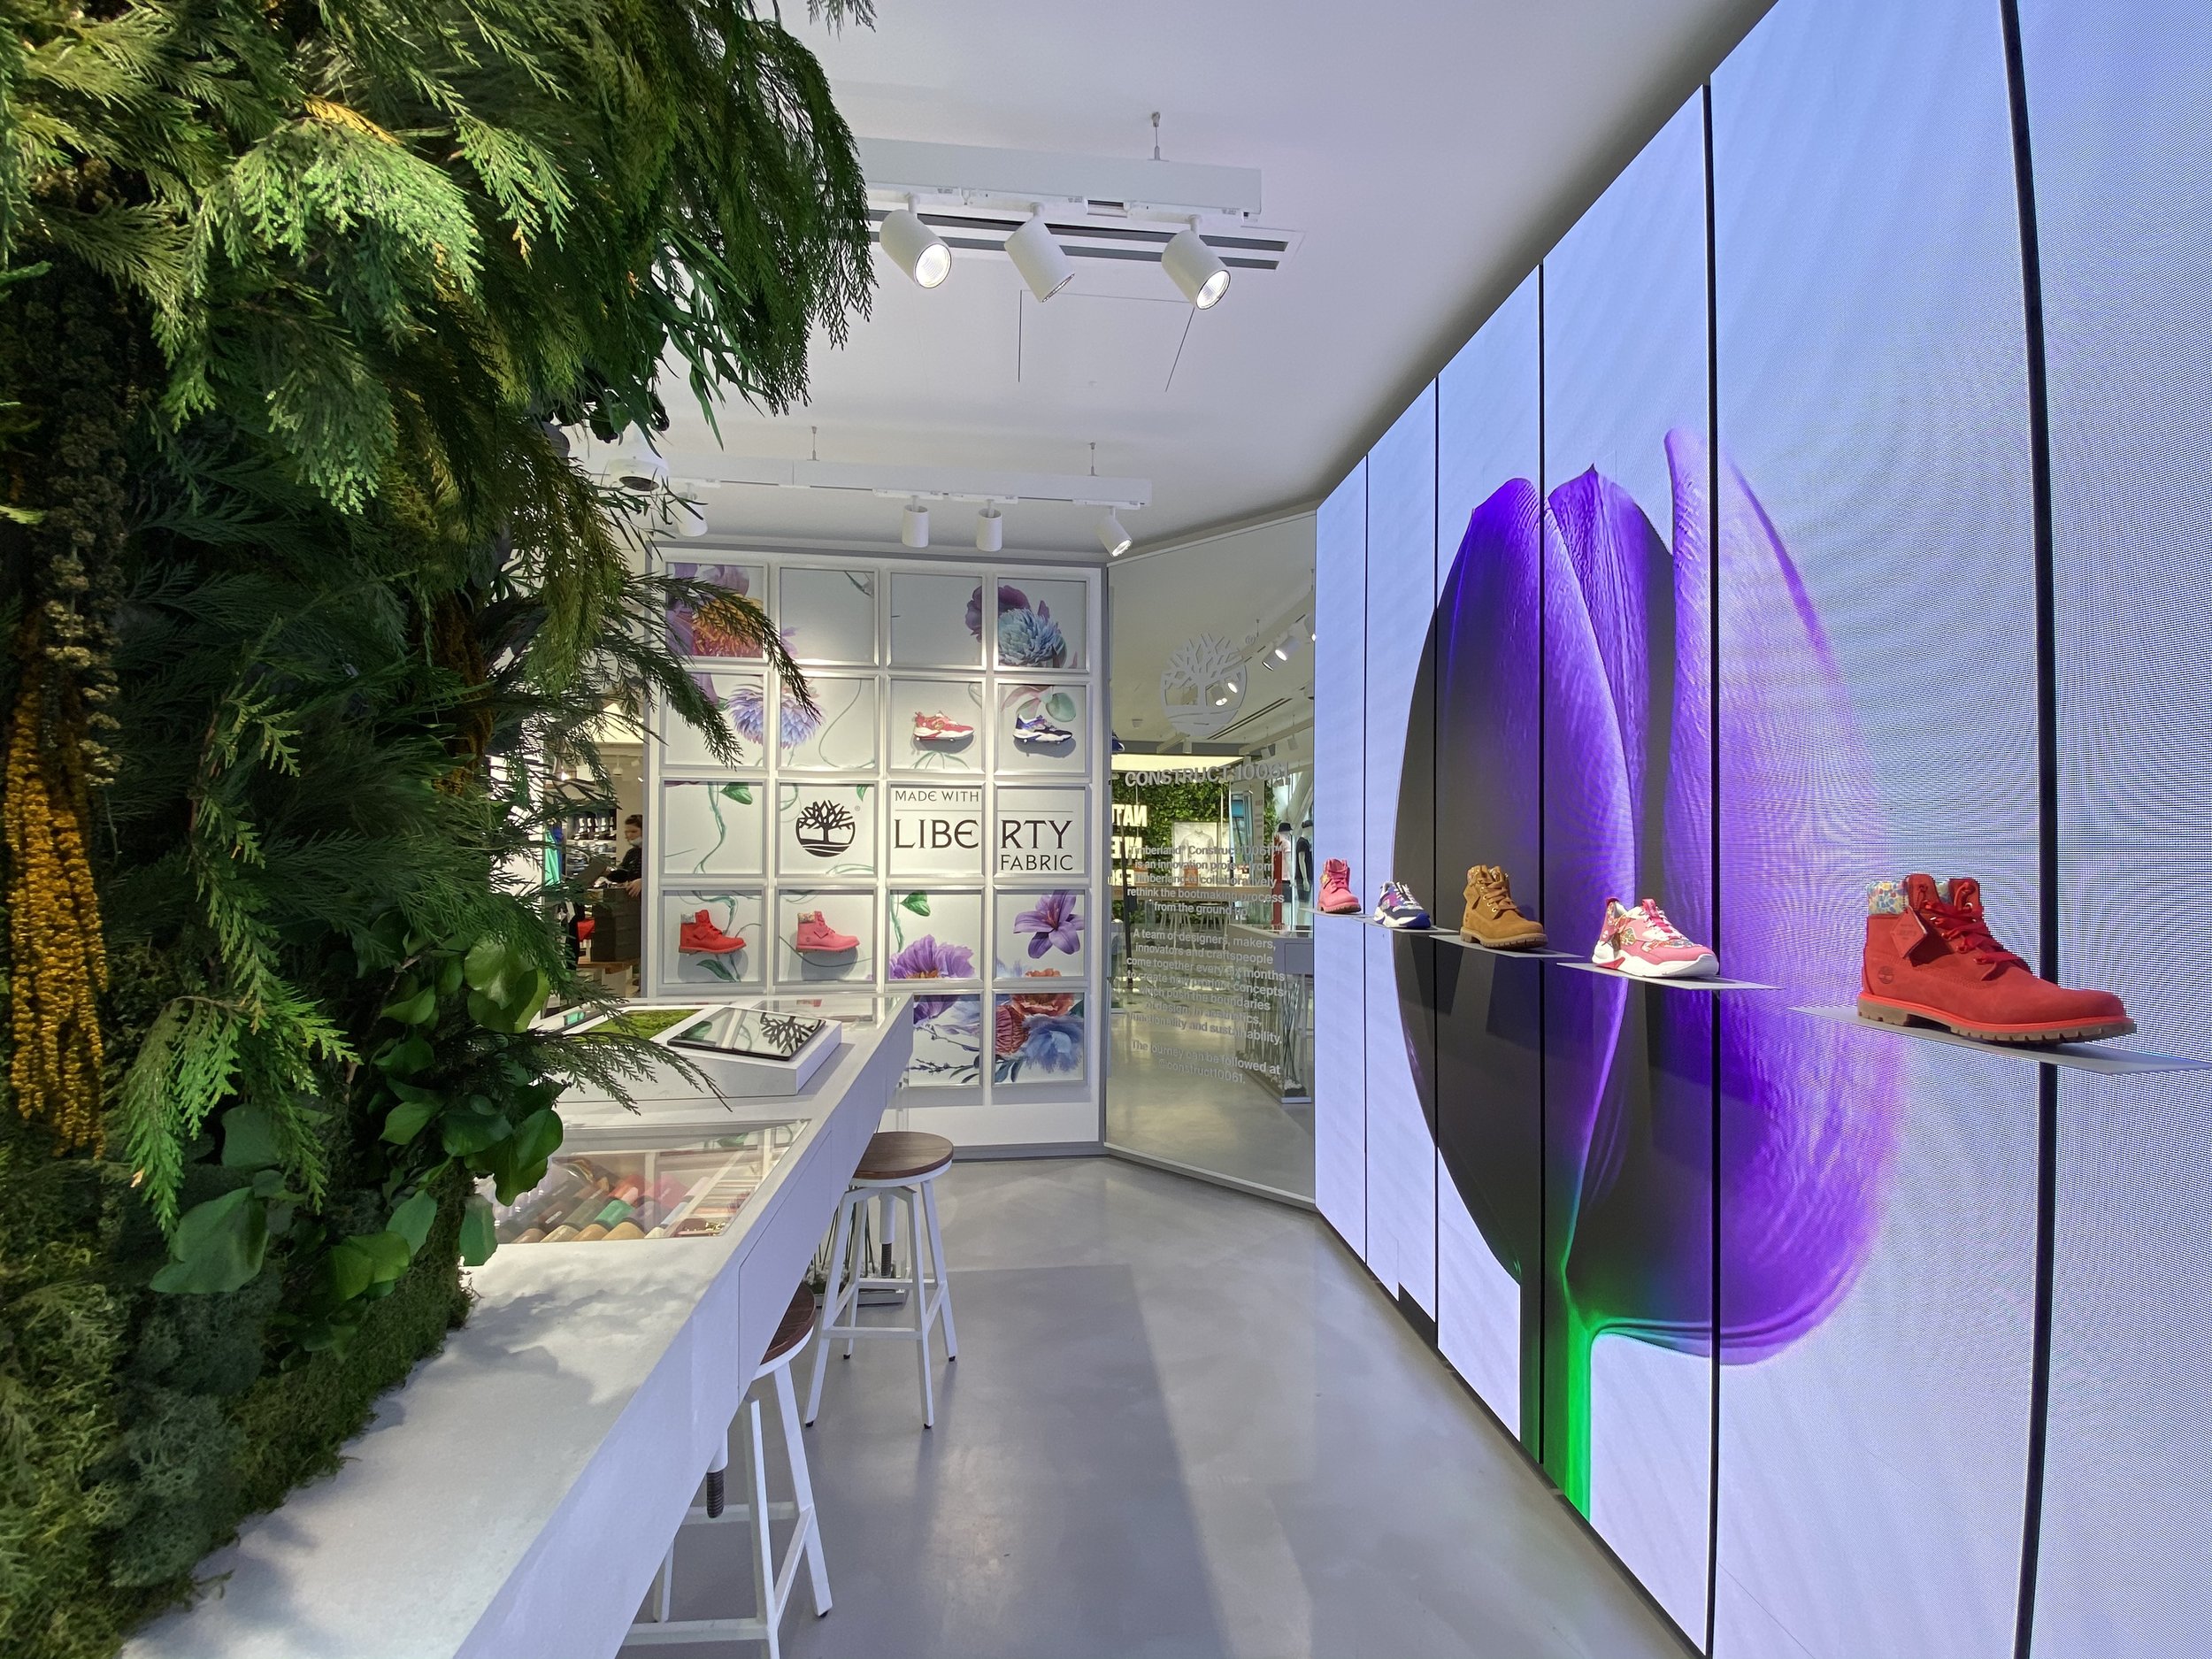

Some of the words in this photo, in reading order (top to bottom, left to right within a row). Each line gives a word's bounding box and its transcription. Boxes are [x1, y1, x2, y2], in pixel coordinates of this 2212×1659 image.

[1125, 765, 1231, 787] CONSTRUCT
[1234, 761, 1288, 781] 10061
[895, 790, 937, 802] MADE
[941, 791, 979, 803] WITH
[1000, 854, 1074, 872] FABRIC
[1135, 859, 1144, 869] is
[1145, 861, 1156, 870] an
[1157, 859, 1209, 871] innovation
[1126, 887, 1159, 897] rethink
[1160, 887, 1177, 898] the
[1178, 888, 1238, 902] bootmaking
[1240, 893, 1285, 903] process
[1154, 901, 1177, 912] from
[1178, 902, 1194, 914] the
[1195, 903, 1233, 917] ground
[1133, 928, 1141, 939] A
[1141, 929, 1165, 941] team
[1167, 931, 1177, 941] of
[1179, 932, 1231, 947] designers,
[1233, 938, 1277, 952] makers,
[1135, 941, 1184, 956] innovators
[1186, 947, 1205, 958] and
[1206, 949, 1274, 966] craftspeople
[1126, 956, 1152, 968] come
[1153, 958, 1194, 972] together
[1195, 964, 1224, 977] every
[1243, 969, 1286, 982] months
[1126, 969, 1137, 980] to
[1138, 972, 1168, 984] create
[1233, 981, 1285, 999] concepts
[1166, 988, 1190, 1001] push
[1192, 991, 1209, 1002] the
[1210, 992, 1271, 1011] boundaries
[1132, 1038, 1149, 1051] The
[1221, 1054, 1267, 1073] followed
[1268, 1064, 1282, 1075] at
